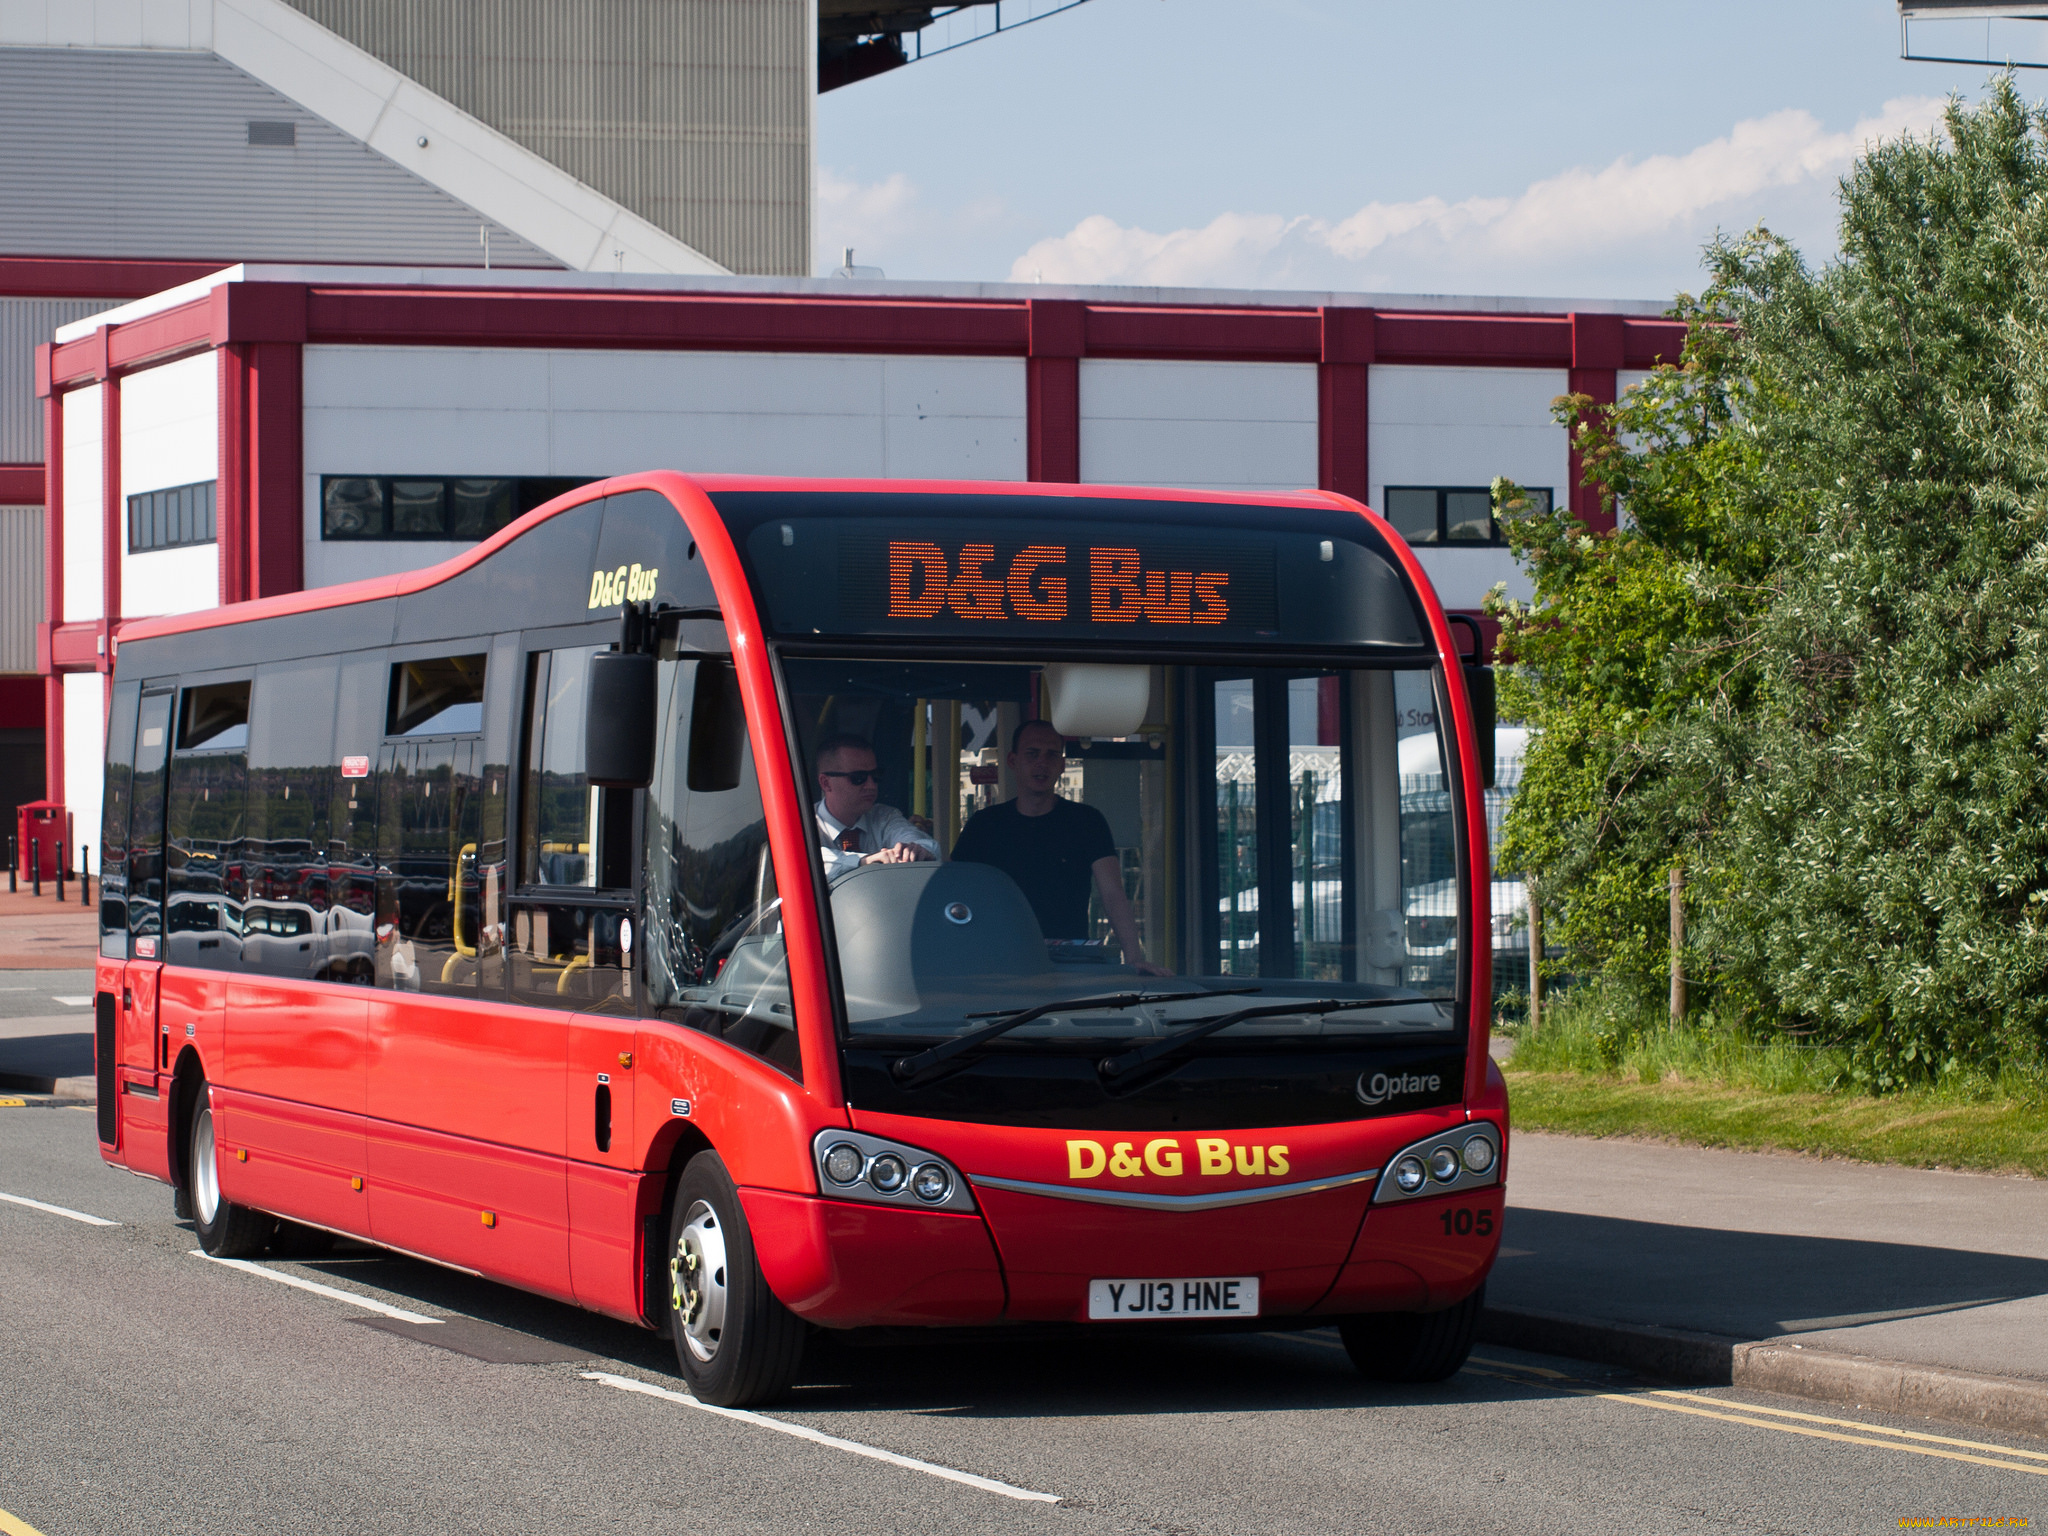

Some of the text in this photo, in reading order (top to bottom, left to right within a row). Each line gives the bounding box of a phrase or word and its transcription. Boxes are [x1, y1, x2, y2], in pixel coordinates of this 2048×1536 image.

[588, 563, 659, 609] D&G Bus
[888, 541, 1230, 625] D&G Bus
[1407, 708, 1434, 727] Sto
[1370, 1072, 1441, 1100] Optare
[1066, 1138, 1290, 1179] D&G Bus
[1440, 1208, 1494, 1236] 105
[1108, 1281, 1241, 1312] YJ13 HNE
